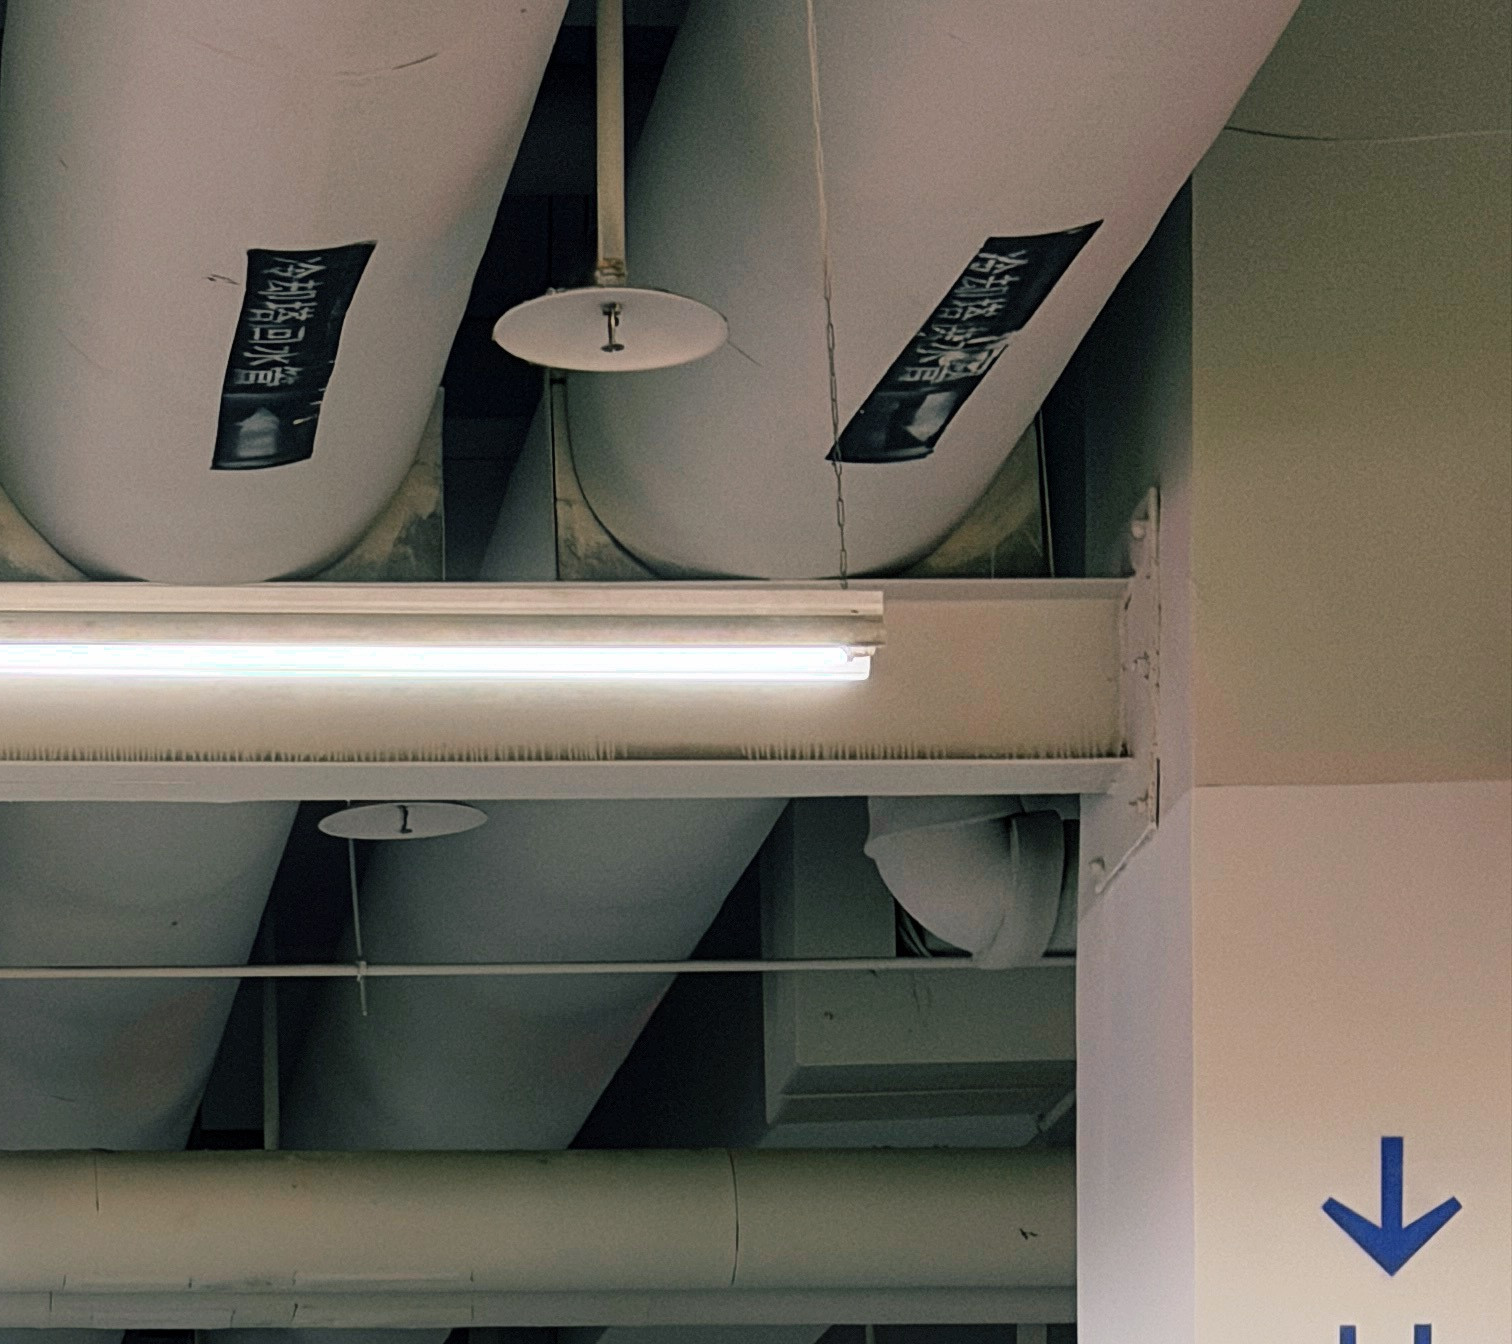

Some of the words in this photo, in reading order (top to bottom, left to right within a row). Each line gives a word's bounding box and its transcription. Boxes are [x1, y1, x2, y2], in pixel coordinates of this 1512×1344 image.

[234, 256, 327, 387] 冷却塔回水管
